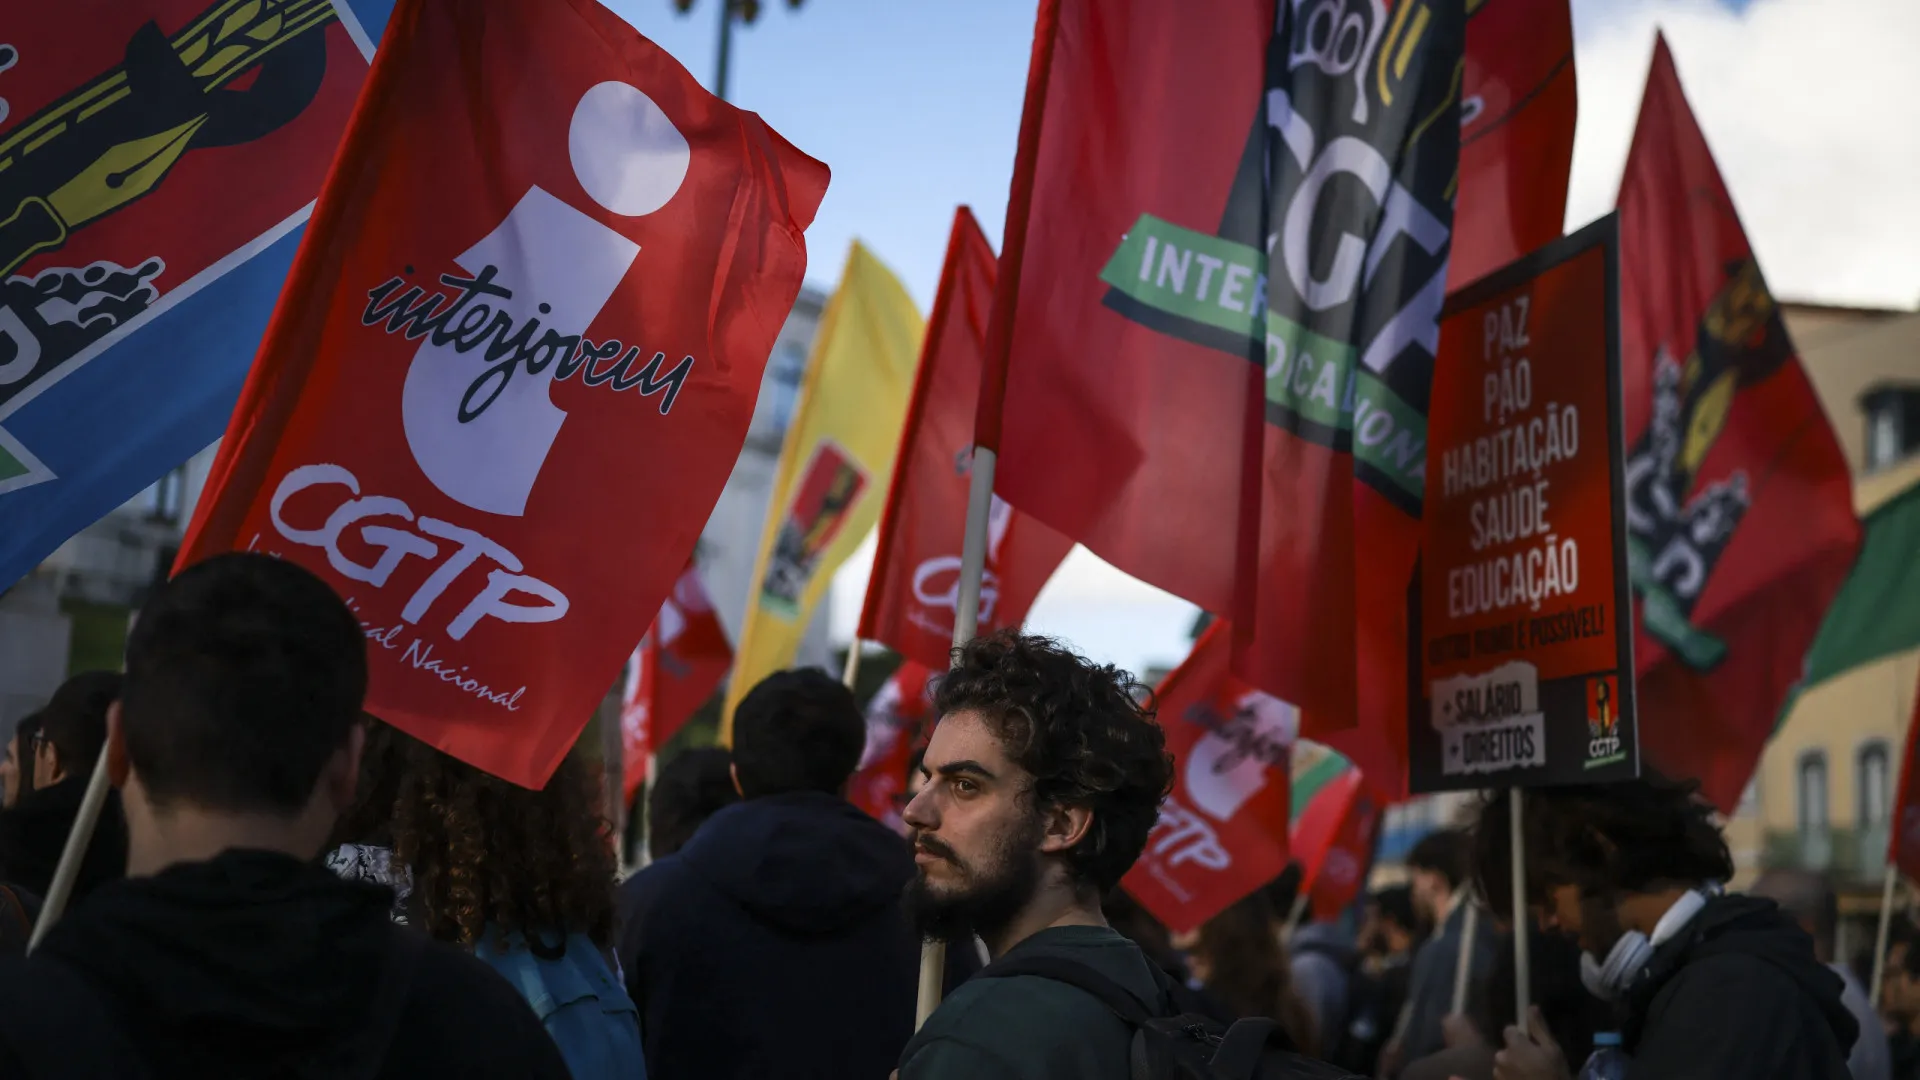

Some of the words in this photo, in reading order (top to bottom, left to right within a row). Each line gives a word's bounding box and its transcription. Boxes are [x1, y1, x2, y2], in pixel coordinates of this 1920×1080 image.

[362, 265, 694, 423] interjovem
[1484, 296, 1530, 361] PAZ
[1484, 357, 1532, 422] PÃO
[1442, 402, 1579, 497] HABITAÇÃO
[1470, 481, 1551, 550] SAÚDE
[270, 463, 569, 641] CGTP
[1448, 535, 1579, 619] EDUCAÇÃO
[400, 638, 526, 711] Nacional
[1455, 680, 1521, 719] SALÁRIO
[1463, 725, 1535, 764] DIREITOS
[1589, 737, 1620, 758] CGTP
